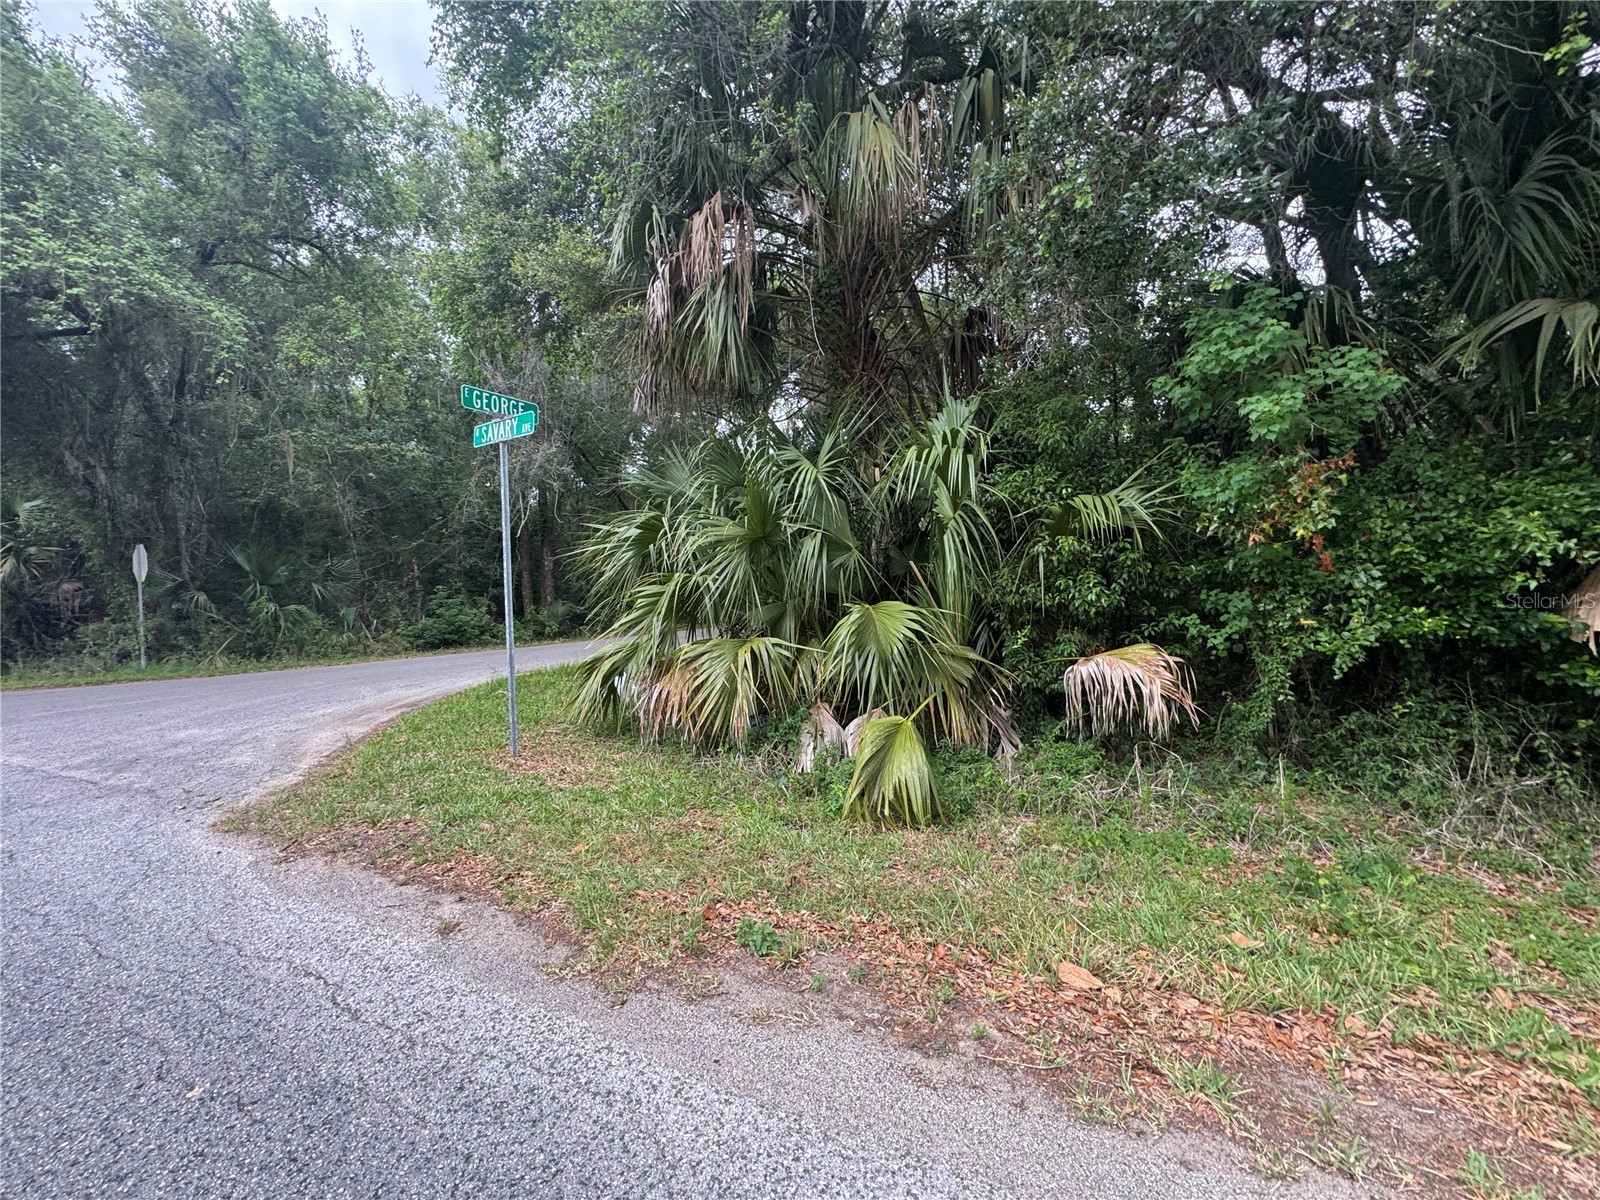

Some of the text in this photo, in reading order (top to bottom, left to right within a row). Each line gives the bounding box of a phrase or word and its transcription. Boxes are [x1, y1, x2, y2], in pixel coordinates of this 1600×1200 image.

[464, 387, 525, 415] E GEORGE
[481, 417, 519, 443] SAVARY
[521, 423, 532, 434] AVE
